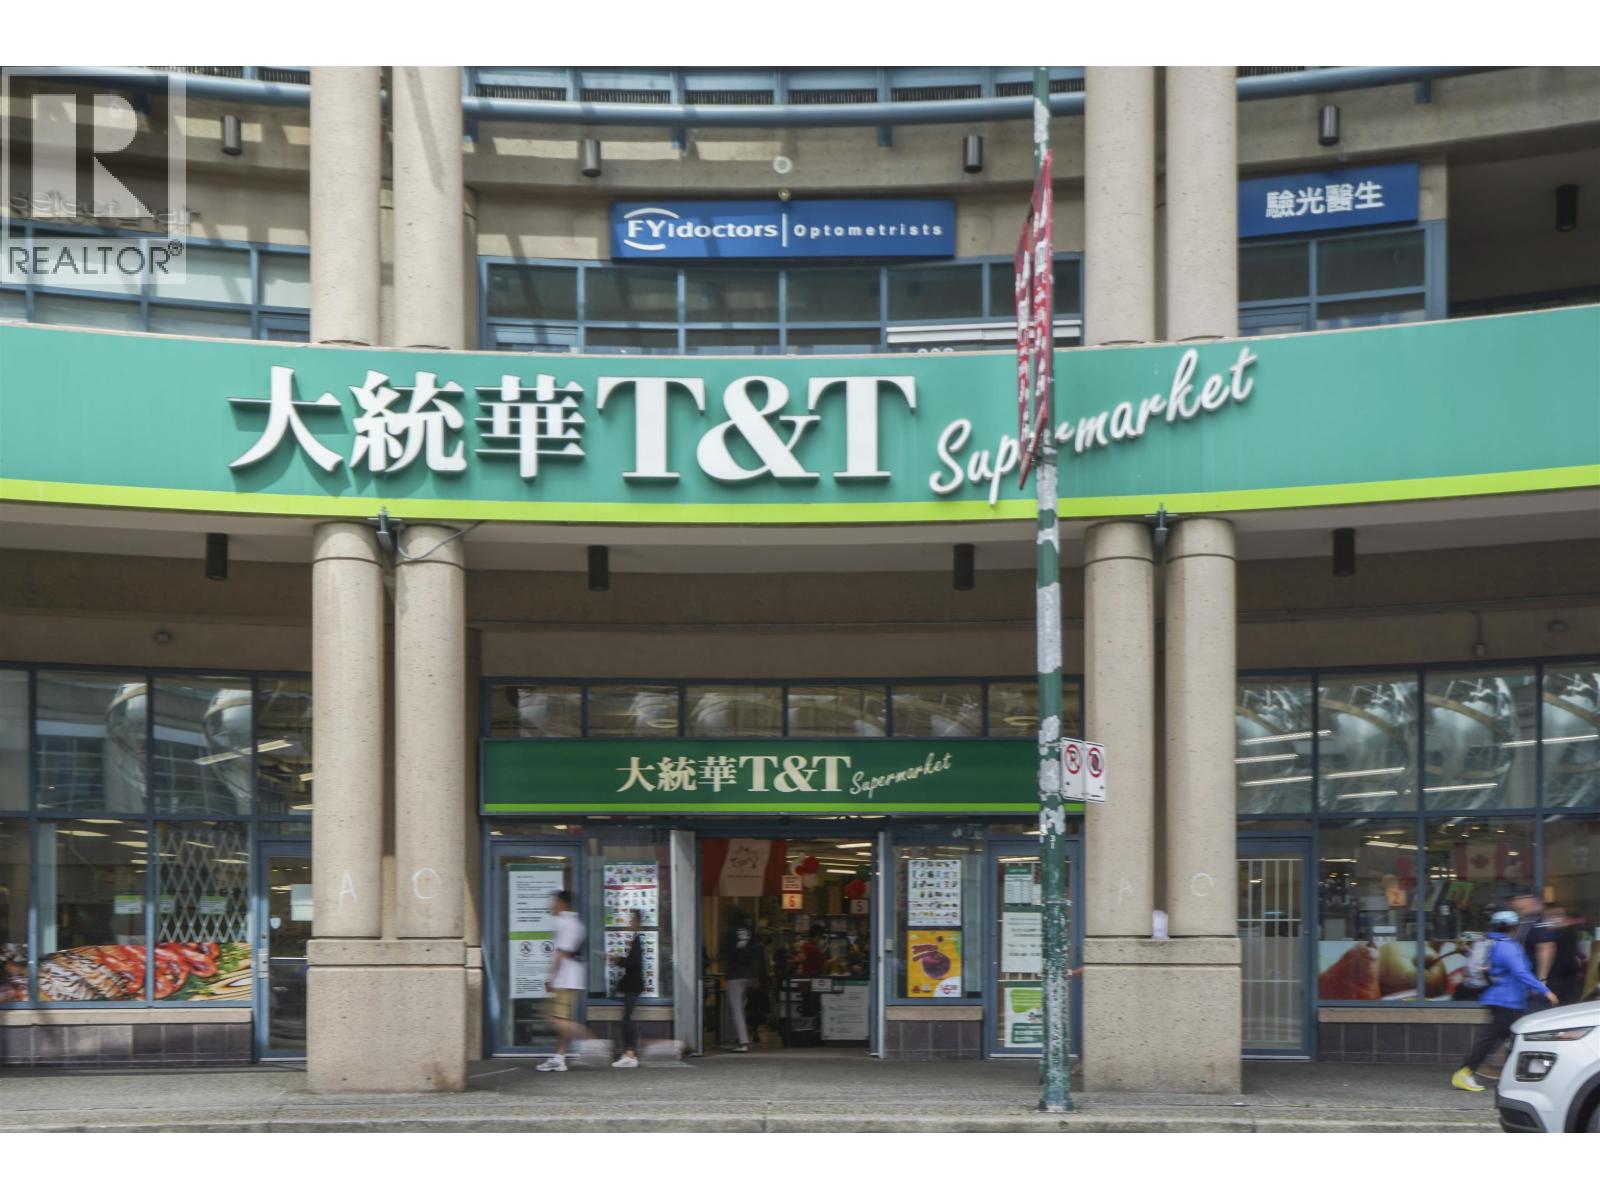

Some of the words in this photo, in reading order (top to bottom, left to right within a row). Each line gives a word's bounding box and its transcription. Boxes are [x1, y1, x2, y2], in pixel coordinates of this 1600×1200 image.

[1265, 180, 1385, 219] 驗光醫生
[793, 222, 944, 240] Optometrists
[226, 365, 586, 479] 大統華
[597, 375, 918, 482] T&T
[928, 346, 1259, 507] Suprmarket
[615, 755, 738, 793] 大統華
[739, 755, 852, 793] T&T
[849, 752, 953, 799] Supermarket
